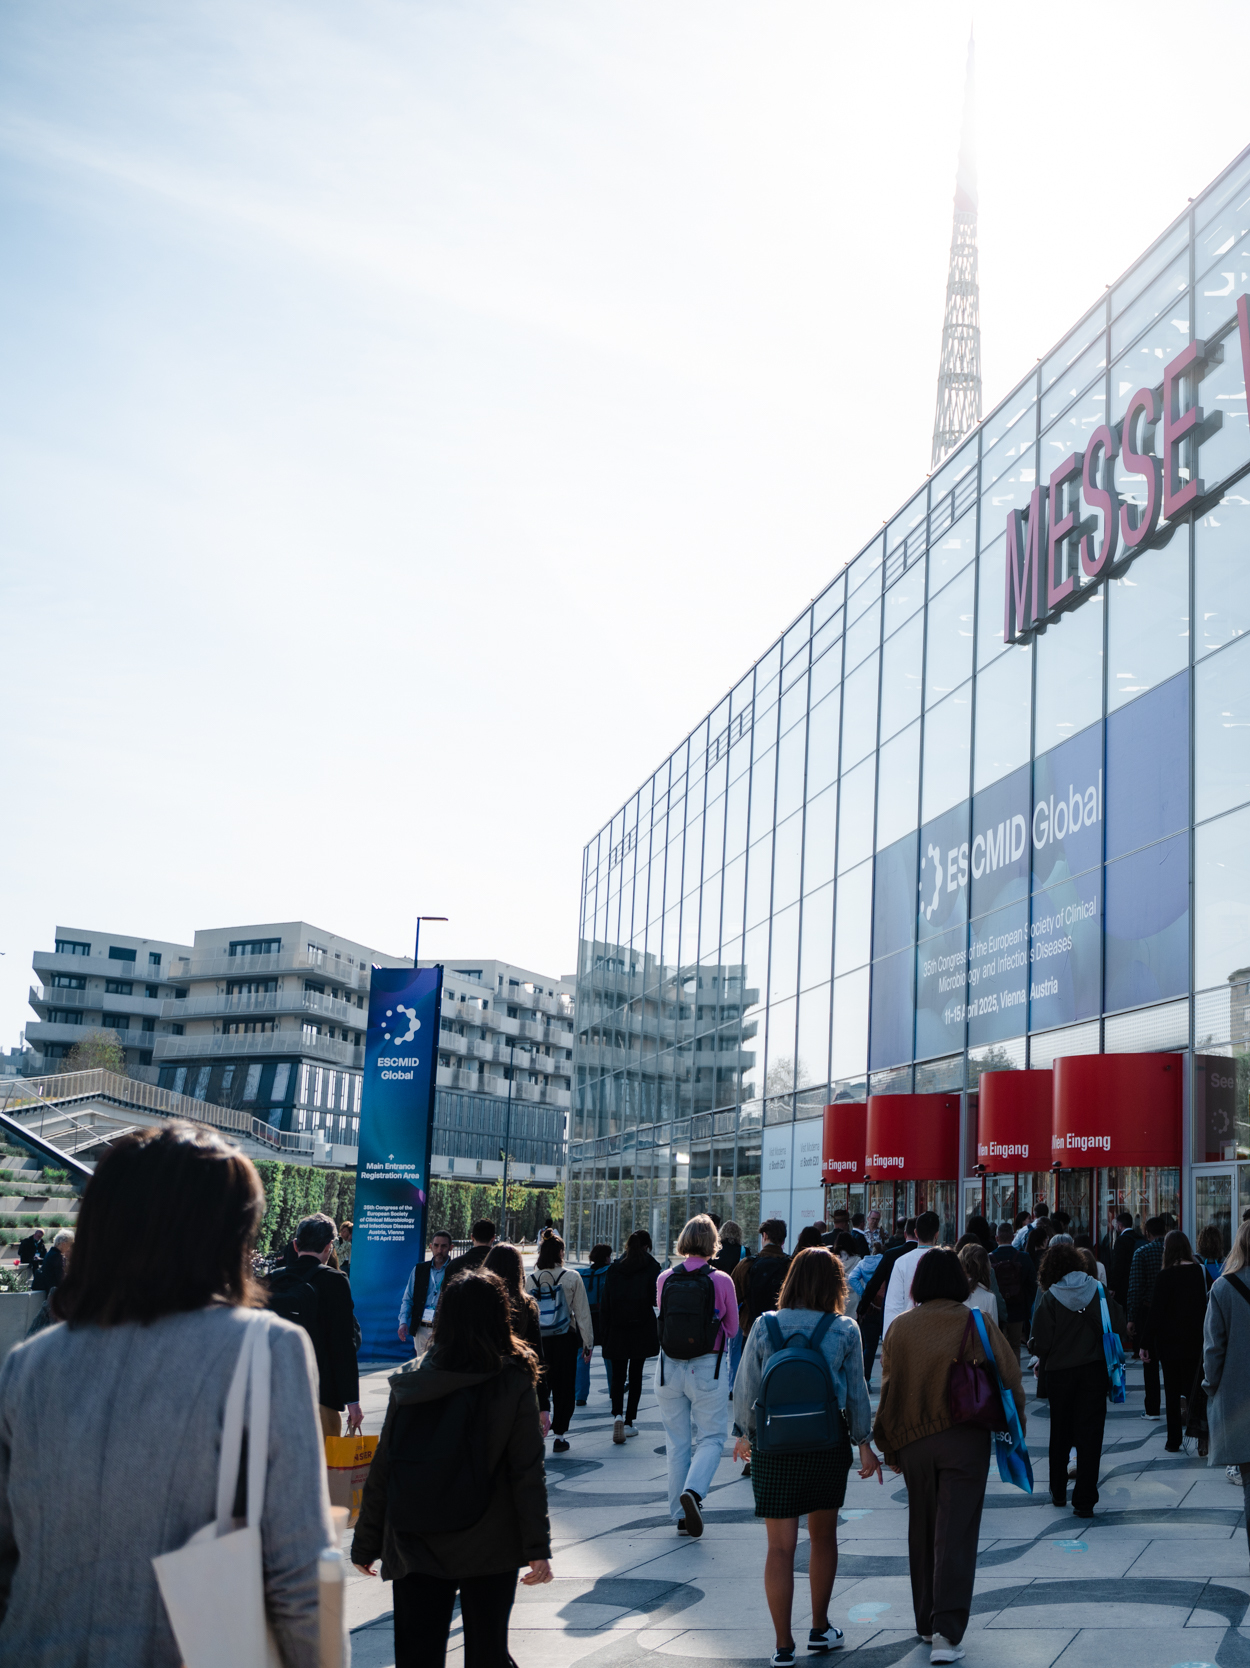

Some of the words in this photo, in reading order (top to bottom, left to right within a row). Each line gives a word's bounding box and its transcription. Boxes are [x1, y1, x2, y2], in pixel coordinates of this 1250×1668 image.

[1004, 339, 1206, 645] MESSE
[947, 814, 1026, 893] ESCMID
[1032, 769, 1102, 850] Global
[923, 958, 938, 977] 35th
[976, 942, 988, 958] the
[989, 928, 1022, 953] European
[1055, 908, 1064, 928] of
[1065, 895, 1097, 925] Clinical
[939, 967, 980, 993] Microbioogy
[982, 958, 996, 978] and
[1036, 935, 1072, 960] Diseases
[979, 994, 999, 1014] 2025,
[1029, 976, 1058, 1000] Austria
[377, 1057, 420, 1067] ESCMID
[381, 1070, 414, 1080] Global
[1210, 1072, 1234, 1089] See
[989, 1141, 1029, 1158] Eingang
[1066, 1133, 1111, 1151] Eingang
[366, 1162, 384, 1170] Main
[385, 1162, 416, 1170] Entrance
[803, 1156, 812, 1167] Booth
[828, 1158, 857, 1172] Eingang
[873, 1154, 905, 1168] Eingang
[361, 1172, 402, 1180] Registration
